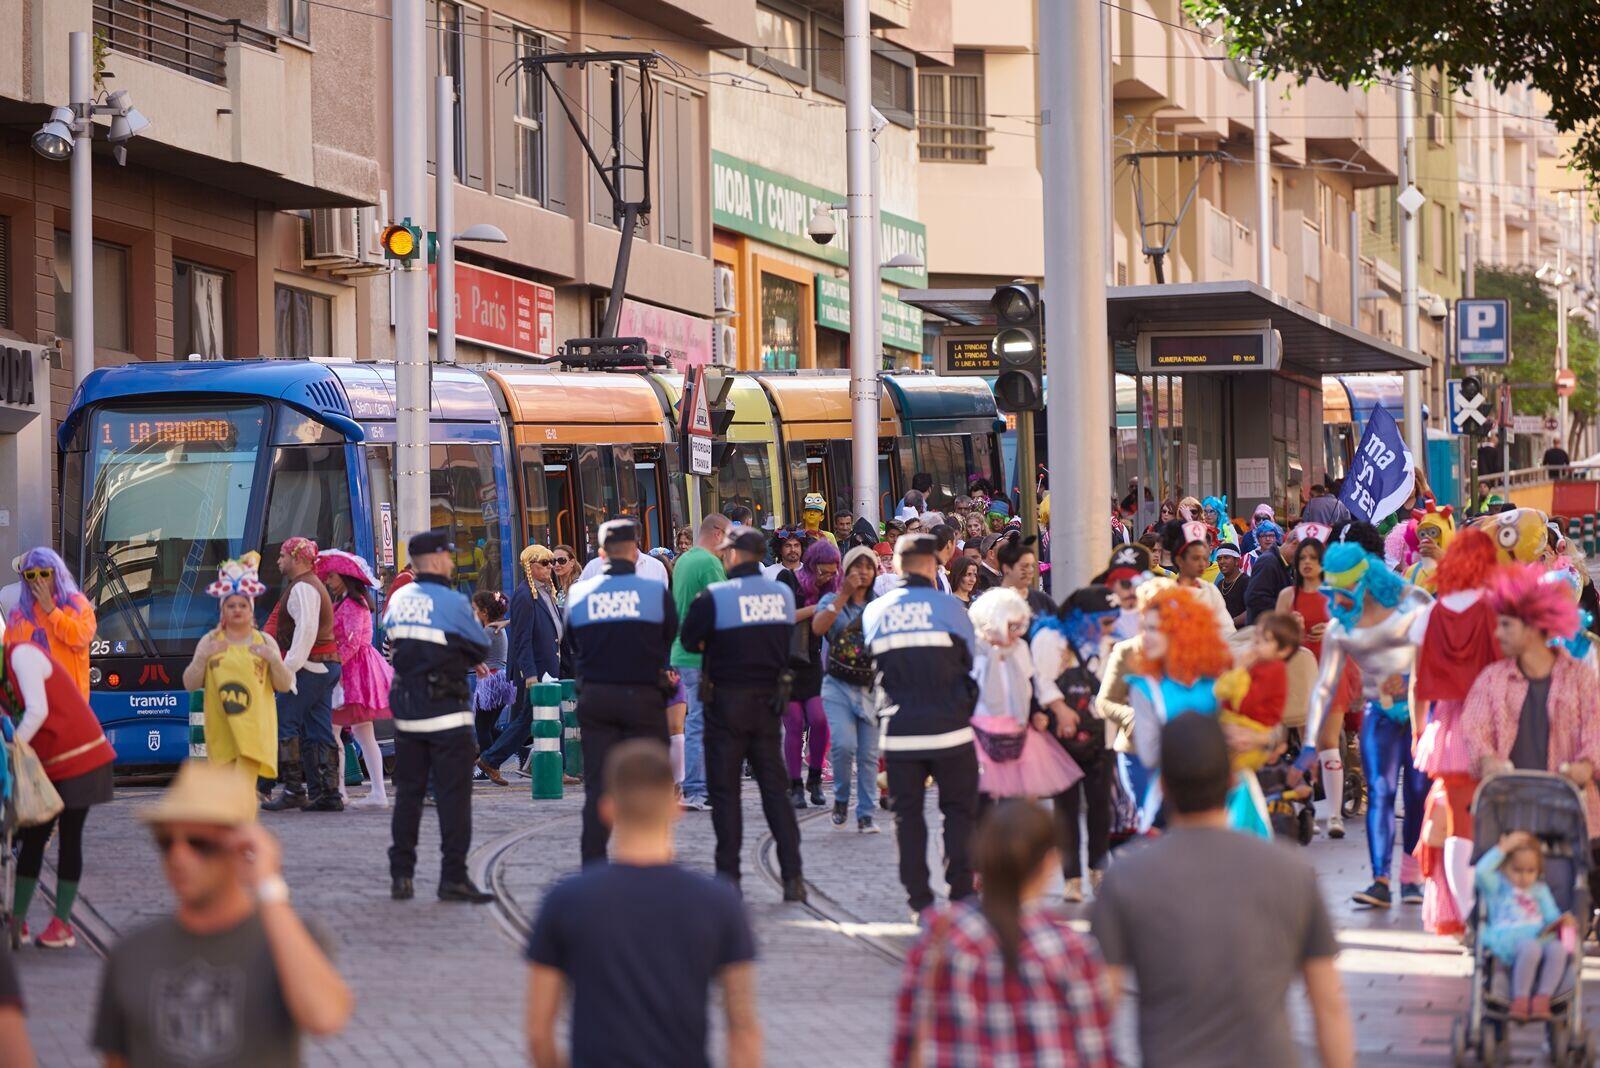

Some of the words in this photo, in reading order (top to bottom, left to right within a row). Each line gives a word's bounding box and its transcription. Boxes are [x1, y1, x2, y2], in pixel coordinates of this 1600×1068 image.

[714, 163, 753, 221] MODA
[755, 178, 765, 224] Y
[472, 285, 507, 331] Paris
[1467, 305, 1496, 338] P
[103, 423, 113, 444] 1
[130, 422, 150, 443] LA
[155, 419, 229, 443] TRINIDAD
[692, 441, 711, 454] PRIORIDAD
[1364, 433, 1396, 470] ma
[391, 605, 432, 626] LOCAL
[588, 601, 641, 621] LOCAL
[741, 604, 787, 623] LOCAL
[881, 612, 933, 634] LOCAL
[91, 641, 110, 655] 25
